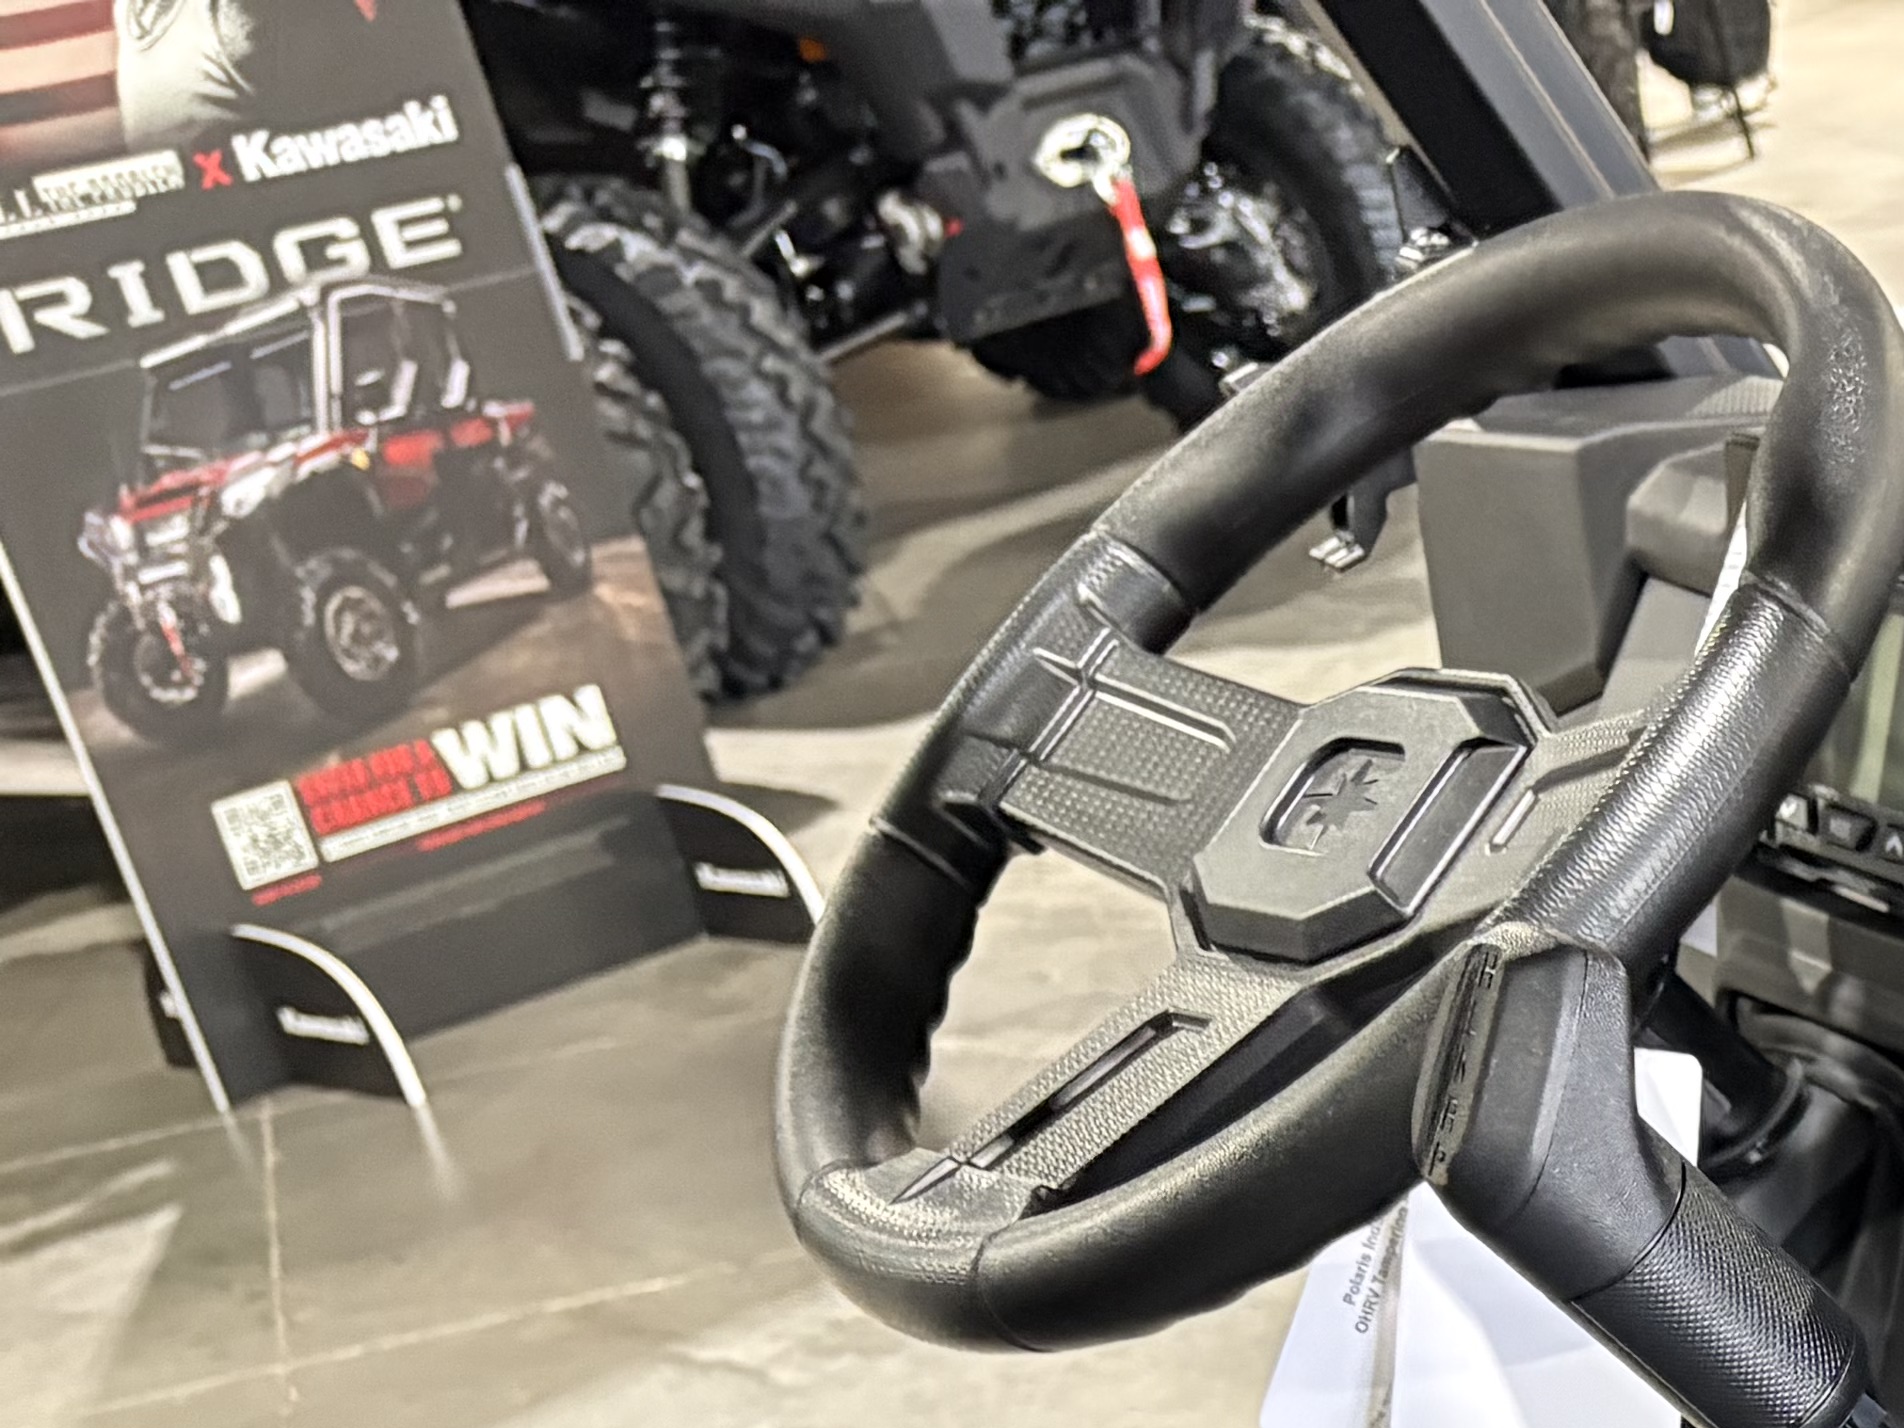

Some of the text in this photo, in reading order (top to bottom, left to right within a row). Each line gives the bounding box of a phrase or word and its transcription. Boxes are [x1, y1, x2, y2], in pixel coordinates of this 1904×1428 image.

[231, 95, 459, 183] Kawasaki
[0, 196, 463, 355] RIDGE
[430, 683, 619, 790] WIN
[1342, 1252, 1373, 1306] Polaris
[1354, 1287, 1381, 1334] OHRV
